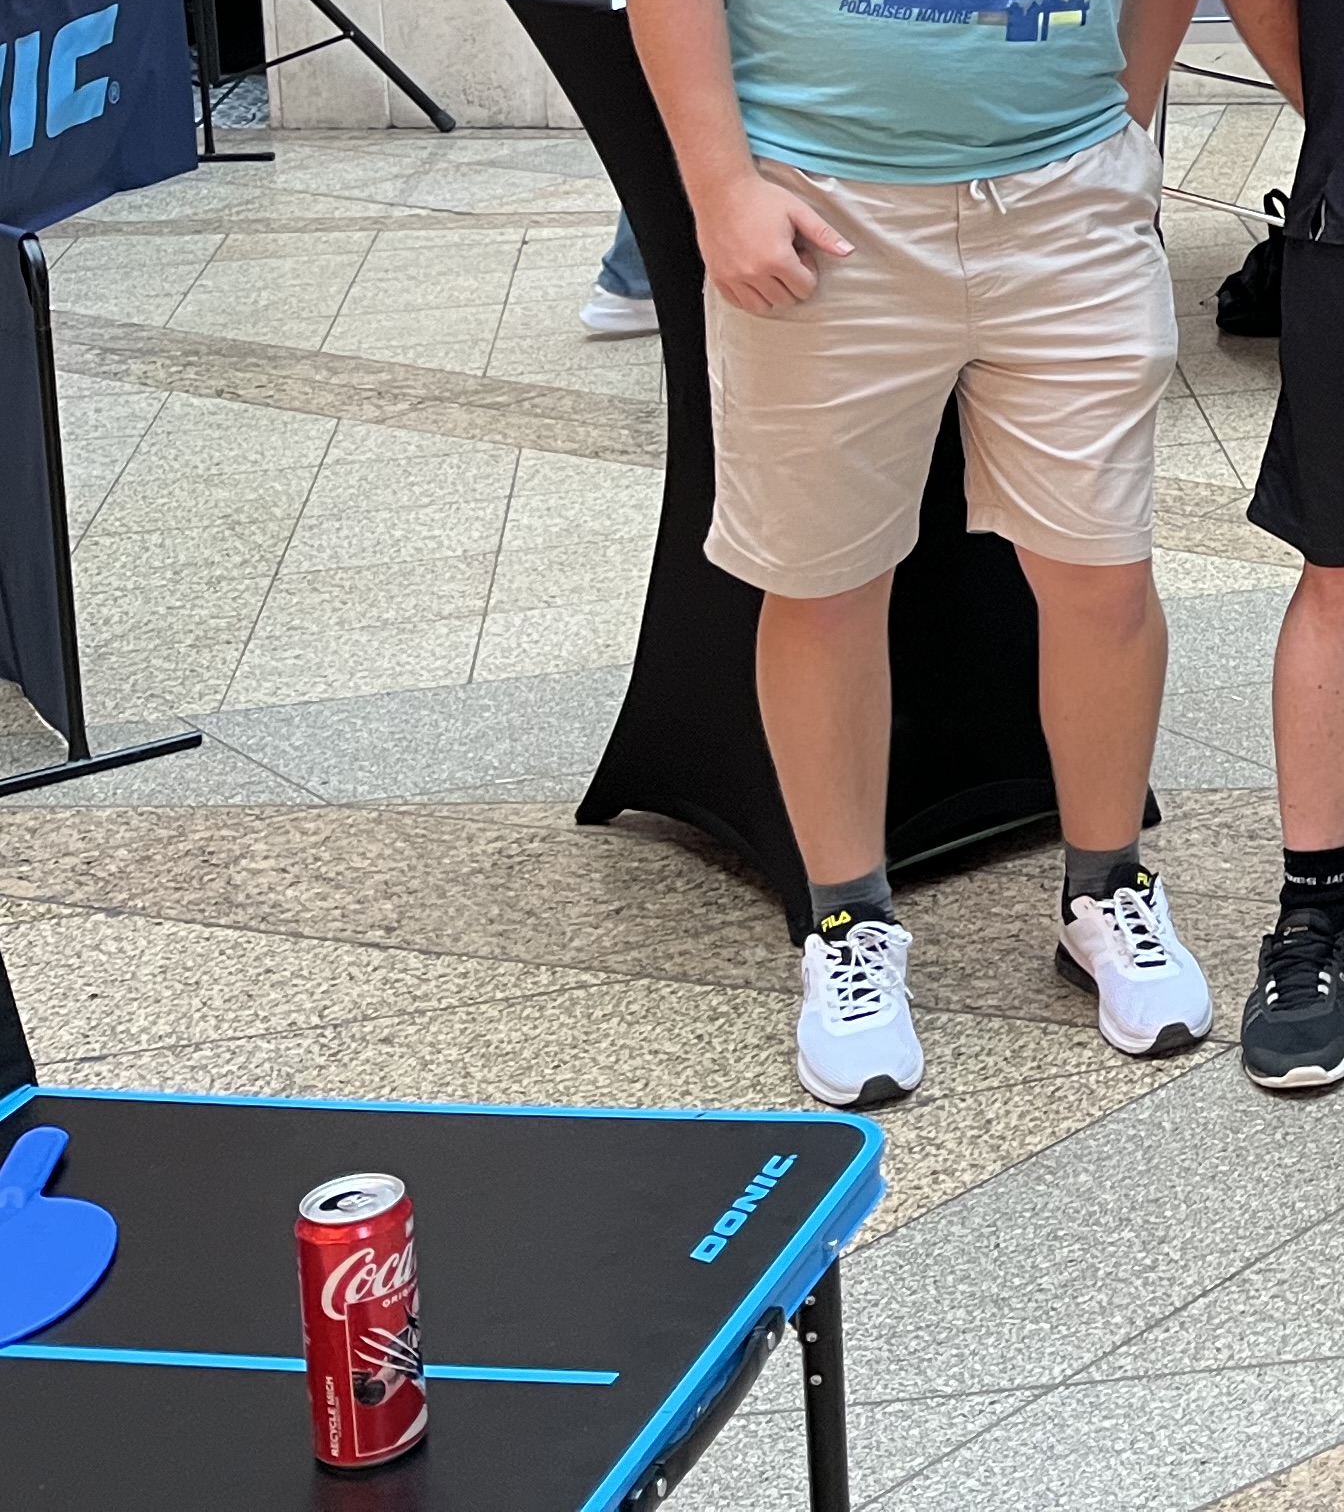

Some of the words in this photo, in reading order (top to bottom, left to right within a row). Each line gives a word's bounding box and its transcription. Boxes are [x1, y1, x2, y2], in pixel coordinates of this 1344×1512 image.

[915, 8, 973, 25] NATURE
[821, 909, 852, 933] FILA
[689, 1154, 797, 1263] DONIC
